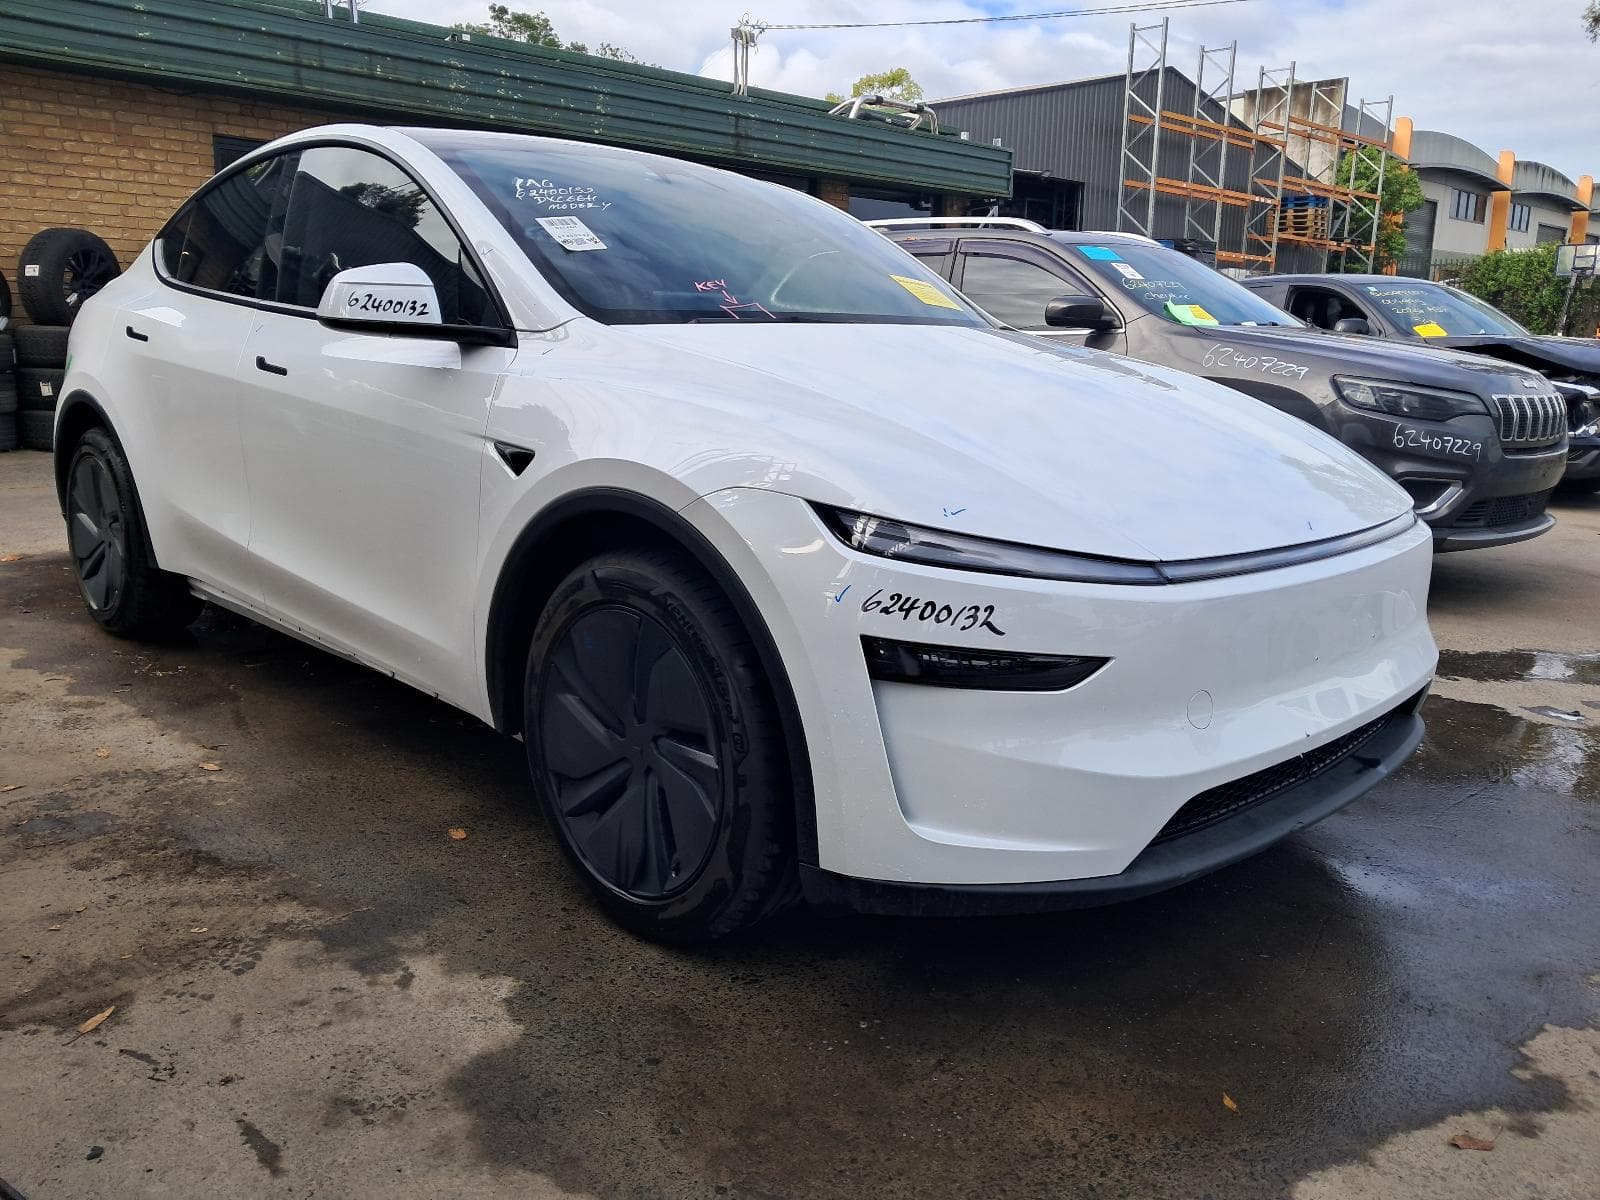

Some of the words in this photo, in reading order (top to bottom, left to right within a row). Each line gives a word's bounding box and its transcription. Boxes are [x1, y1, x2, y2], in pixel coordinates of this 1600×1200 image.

[347, 291, 430, 316] 62400132
[694, 279, 727, 292] KEY
[1202, 343, 1310, 380] 62407229
[1393, 424, 1482, 461] 62407229
[861, 588, 1006, 636] 62400132
